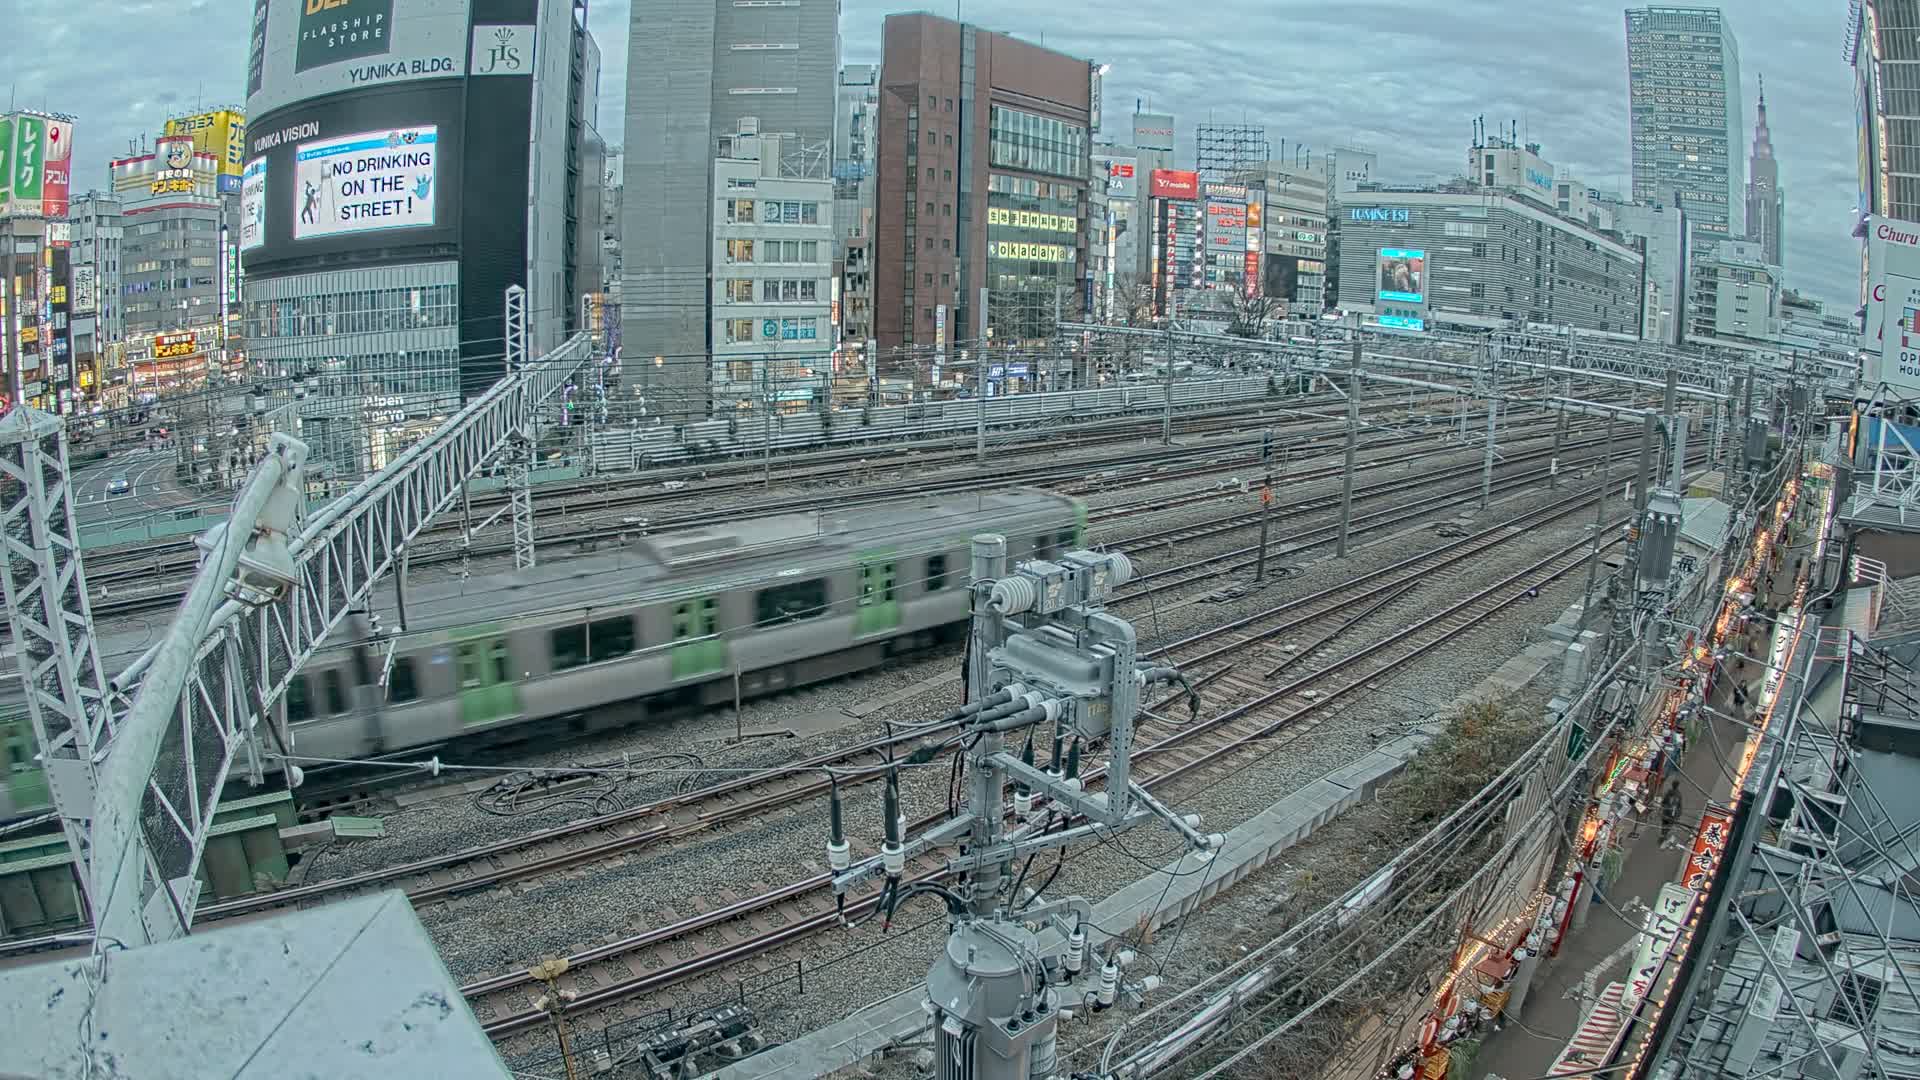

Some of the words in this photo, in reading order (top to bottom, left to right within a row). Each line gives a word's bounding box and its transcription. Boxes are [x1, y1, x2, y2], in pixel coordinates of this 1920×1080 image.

[303, 14, 383, 40] FLAGSHIP
[328, 28, 382, 47] STORE
[350, 61, 407, 83] YUNIKA
[411, 57, 455, 74] BLDG.
[254, 131, 281, 152] YUNIKA
[282, 120, 319, 144] VISION
[22, 121, 37, 188] レイク
[333, 160, 353, 176] NO
[357, 152, 431, 173] DRINKING
[46, 169, 67, 184] アコム
[341, 182, 364, 196] ON
[371, 175, 405, 193] THE
[1000, 242, 1065, 259] okadaya
